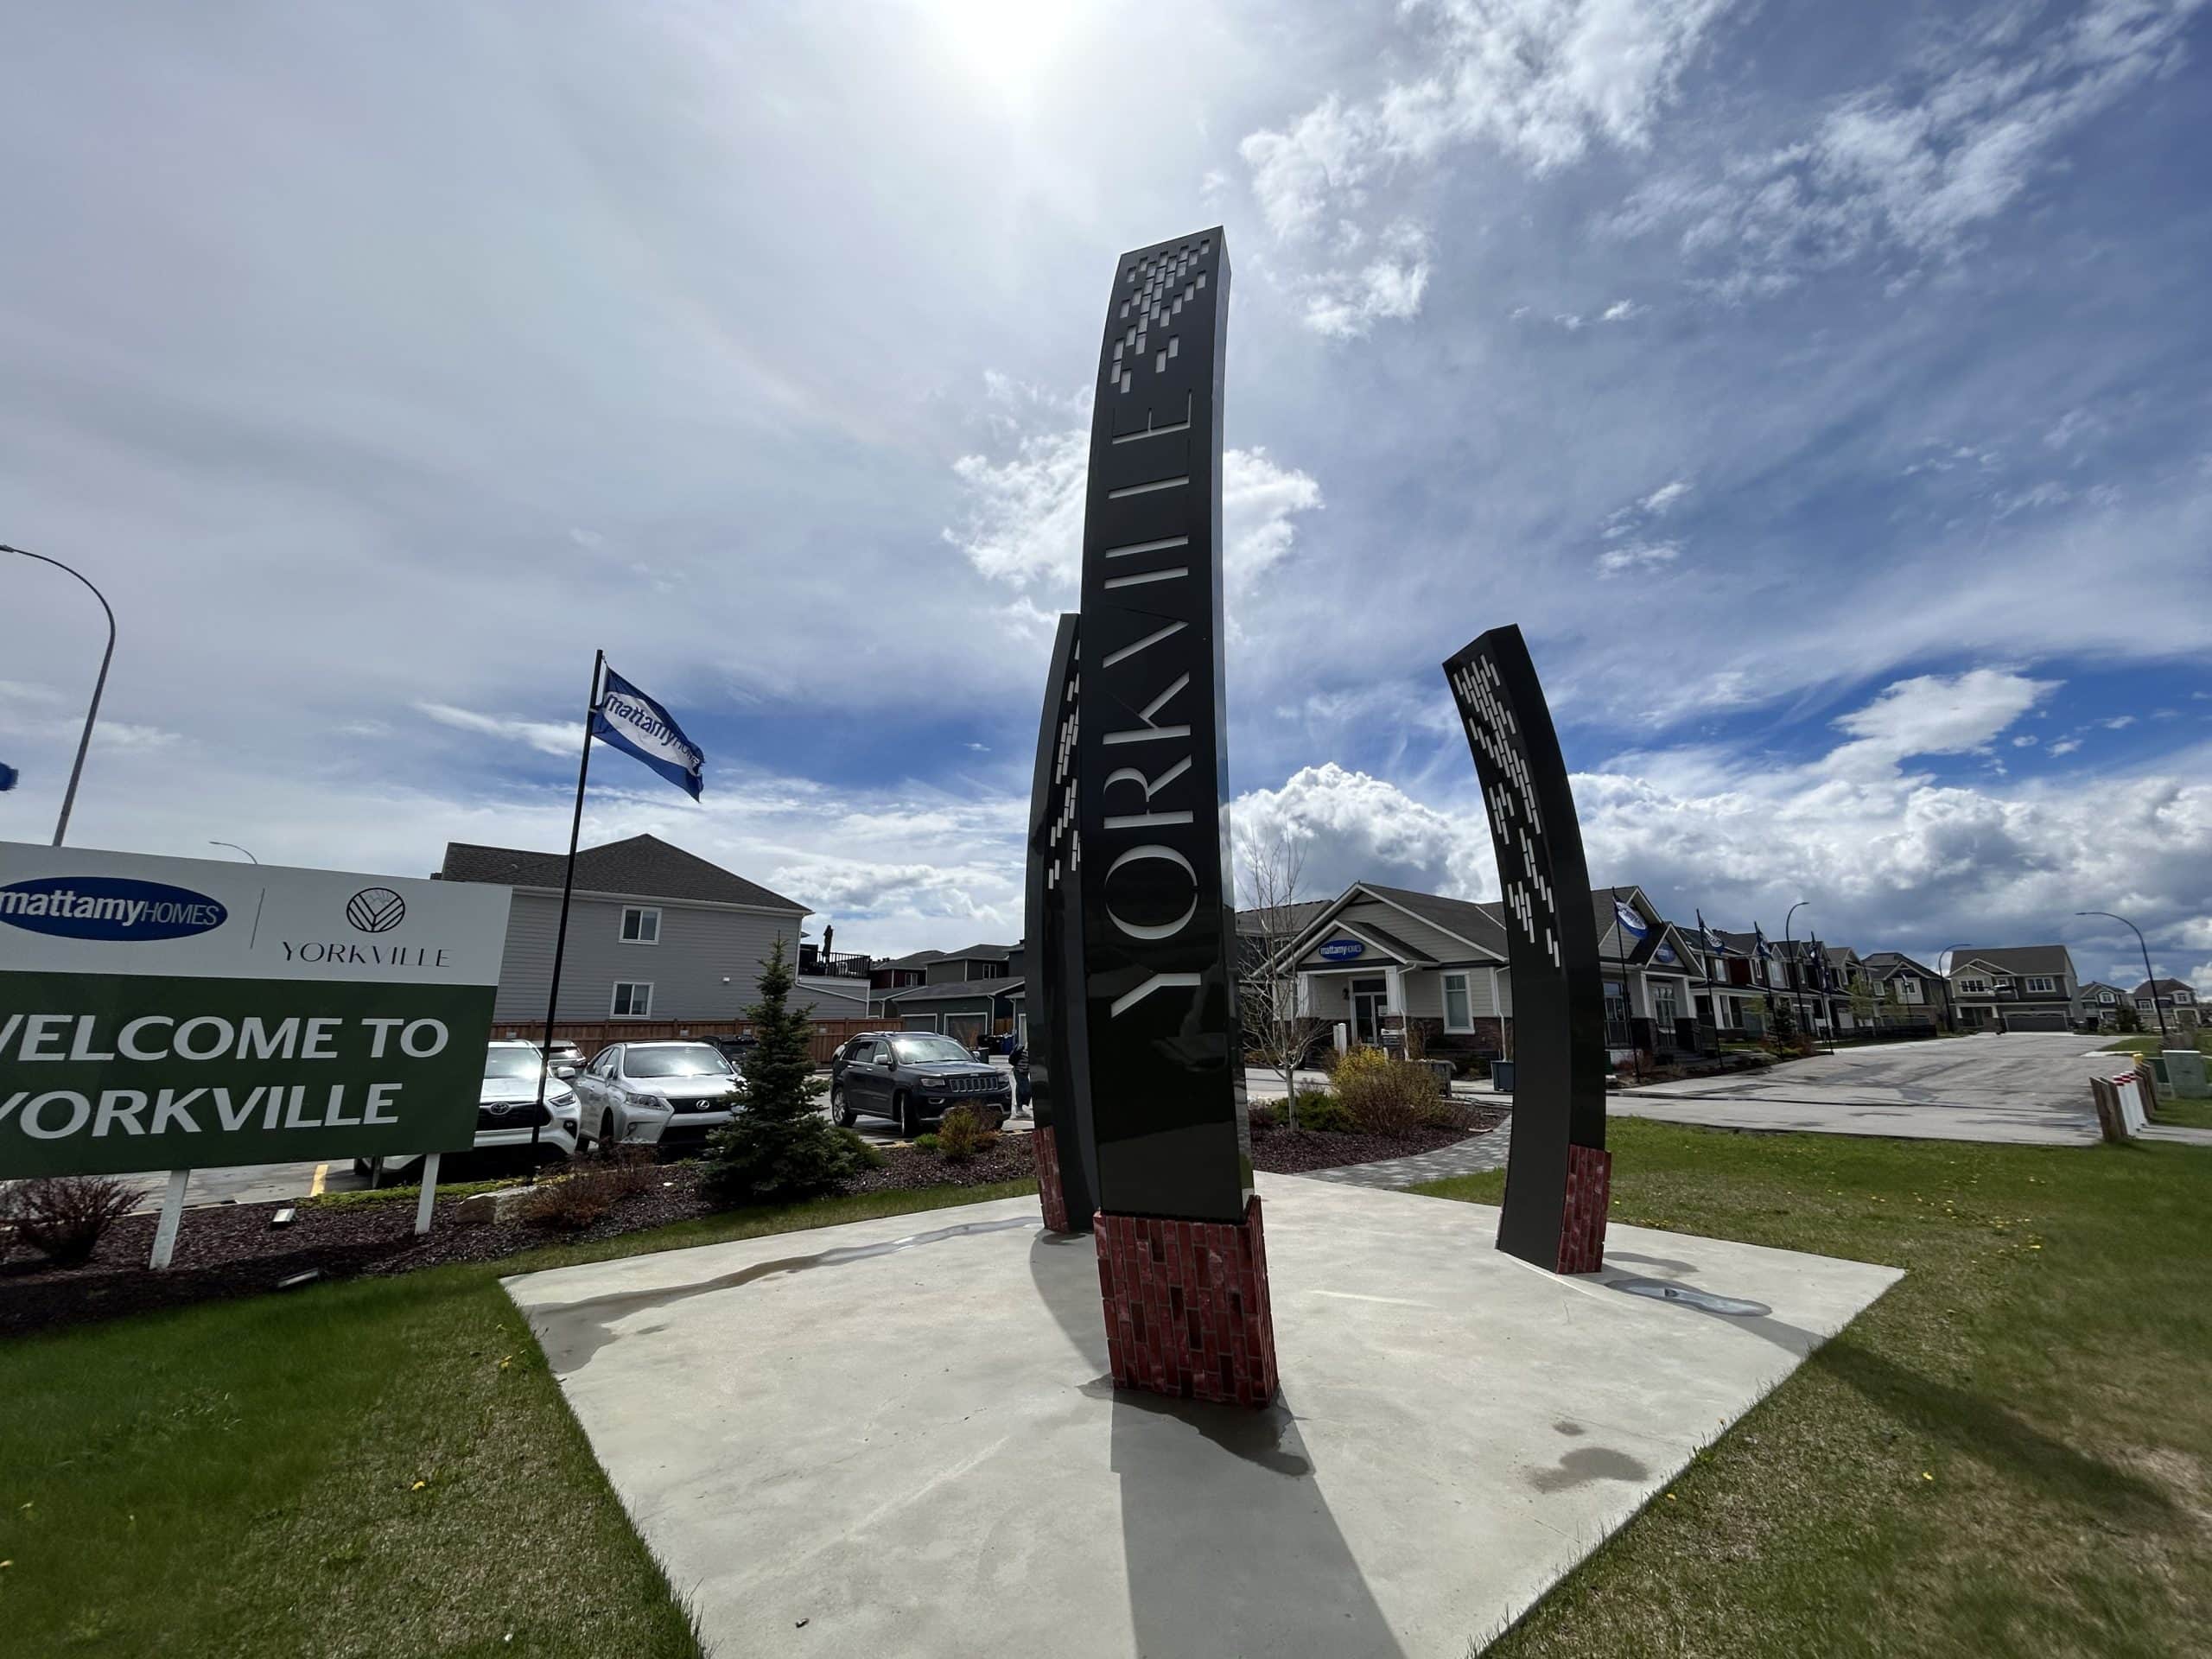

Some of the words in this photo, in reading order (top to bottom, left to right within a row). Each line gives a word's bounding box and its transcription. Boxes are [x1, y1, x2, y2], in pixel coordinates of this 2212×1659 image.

[1102, 389, 1201, 1020] YORKVILLE
[0, 890, 219, 926] mattamyHOMES
[283, 942, 451, 968] YORKVILLE
[361, 1018, 449, 1058] TO
